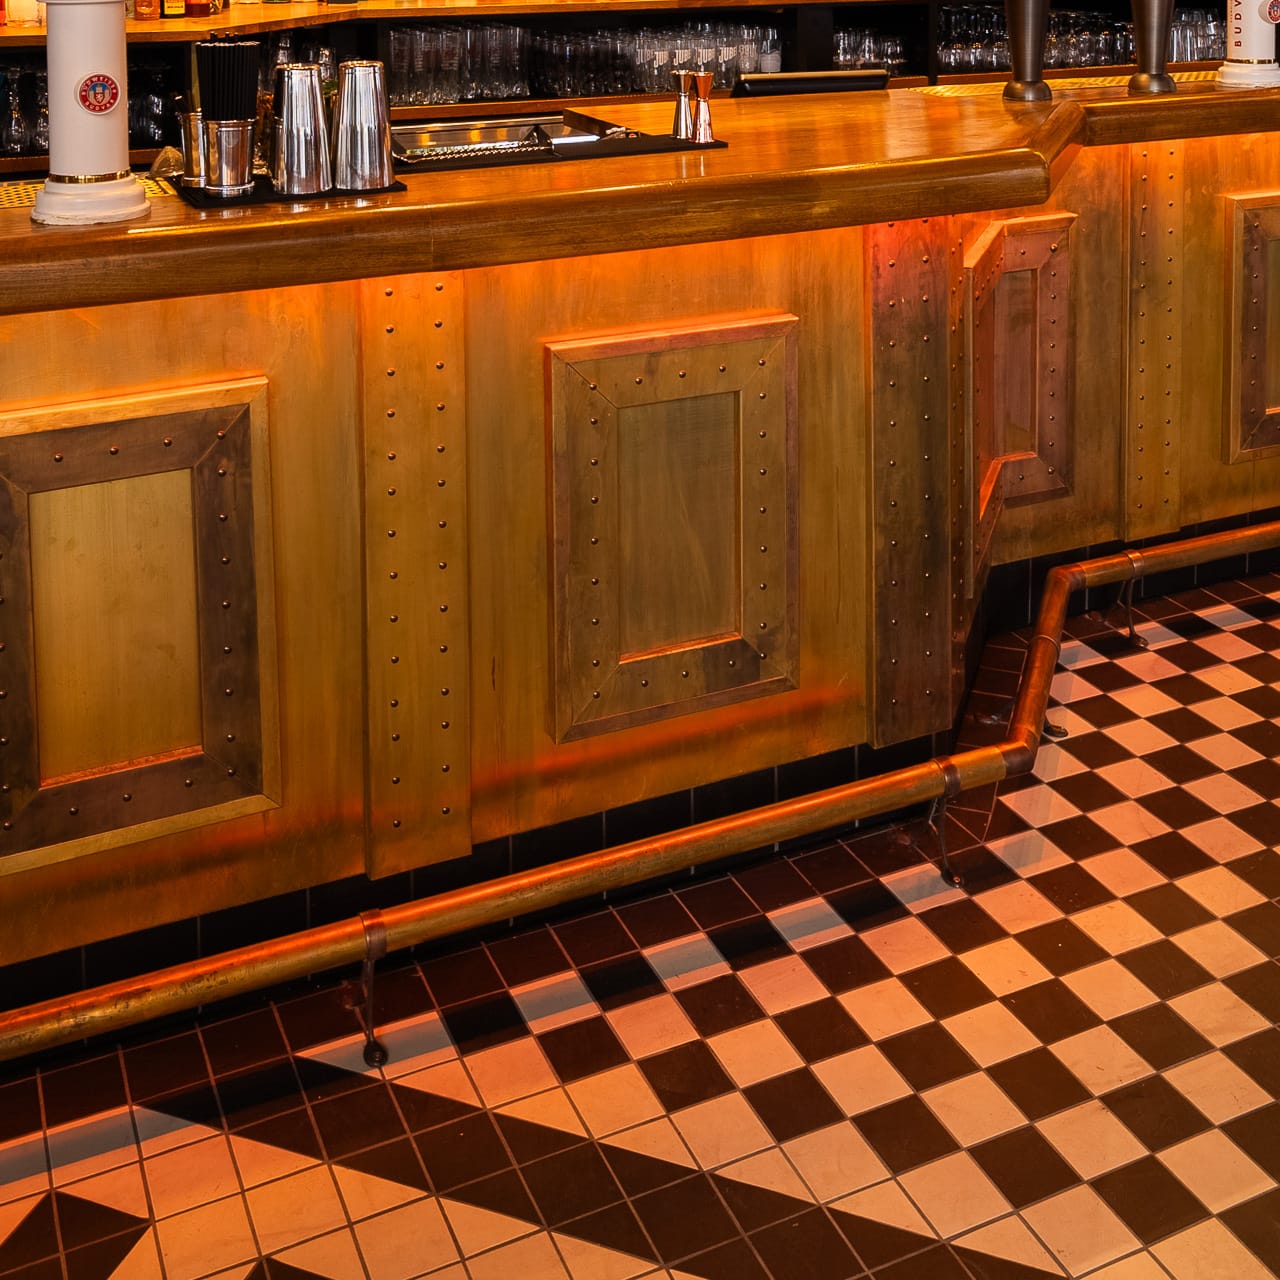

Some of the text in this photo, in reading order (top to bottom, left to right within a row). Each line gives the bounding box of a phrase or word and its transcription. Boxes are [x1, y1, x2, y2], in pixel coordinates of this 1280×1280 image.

[673, 49, 691, 65] JUBE
[697, 48, 715, 65] JUBE
[719, 46, 738, 63] JUBE
